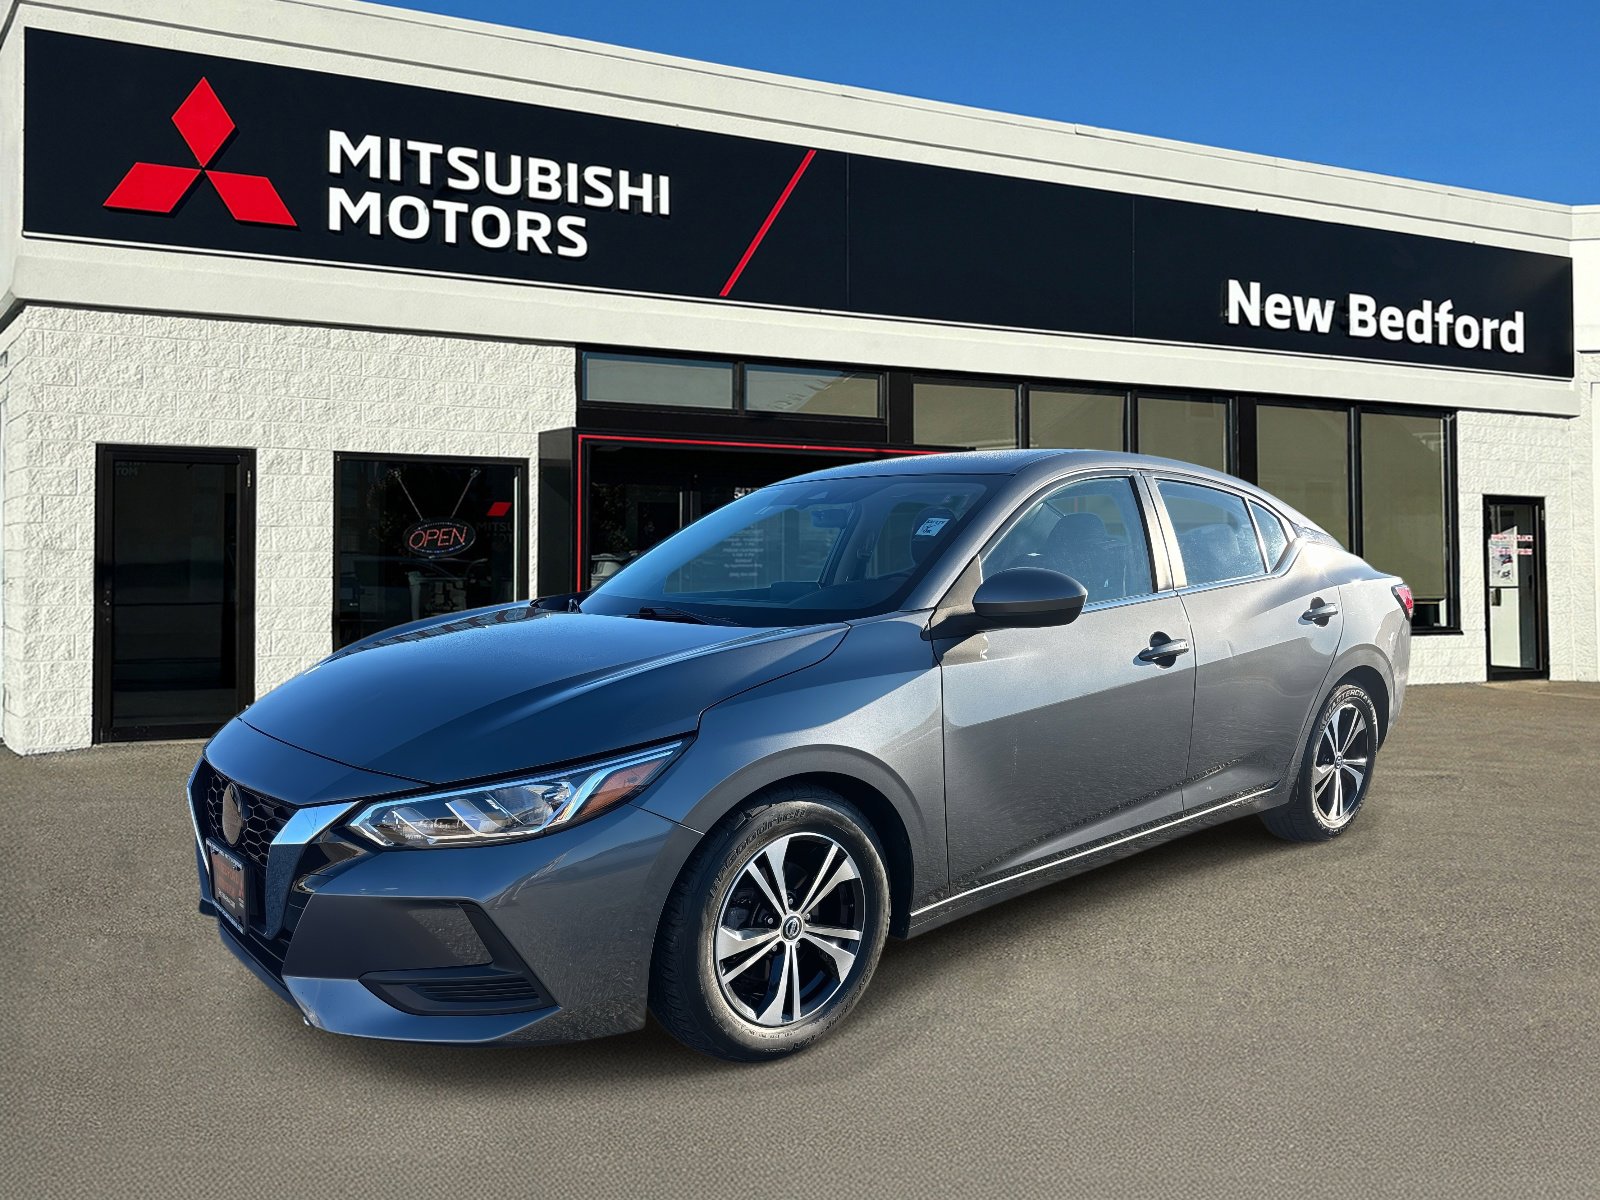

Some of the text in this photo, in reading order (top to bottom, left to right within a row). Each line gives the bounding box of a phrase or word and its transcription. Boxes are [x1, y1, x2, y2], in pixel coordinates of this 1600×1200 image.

[328, 129, 670, 216] MITSUBISHI
[328, 186, 588, 258] MOTORS
[1227, 279, 1525, 353] New Bedford
[409, 526, 468, 549] OPEN
